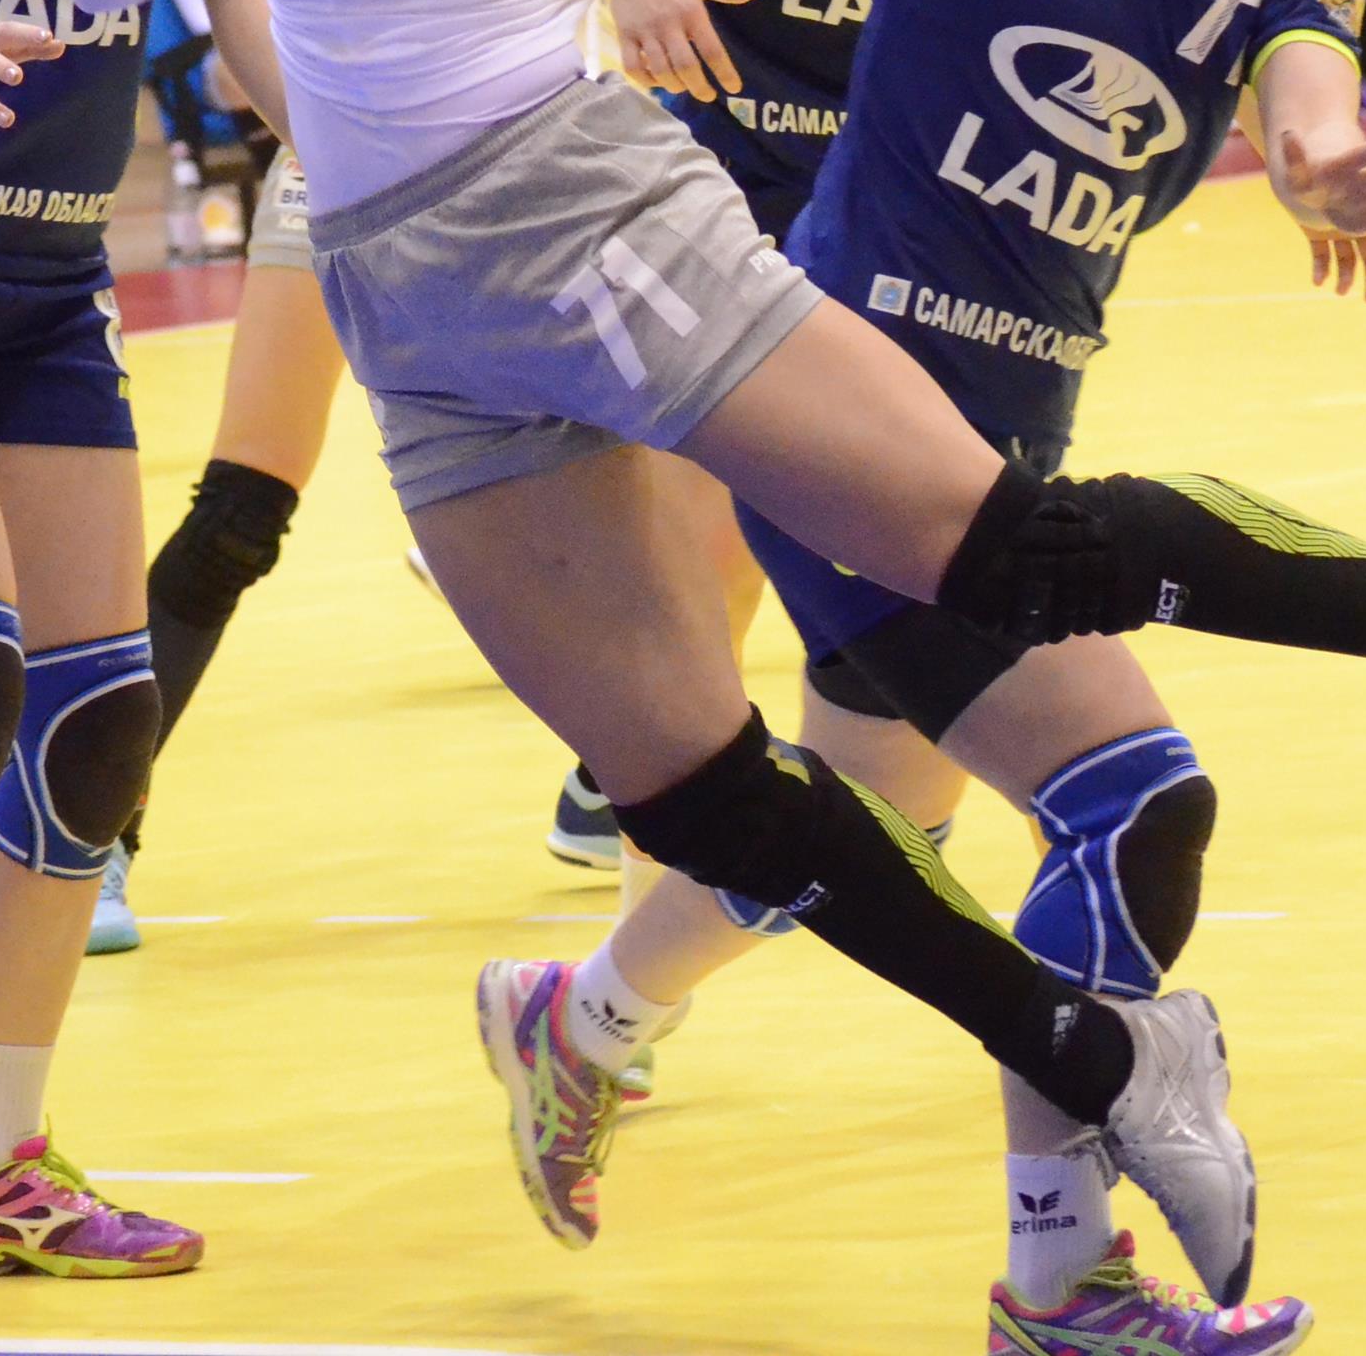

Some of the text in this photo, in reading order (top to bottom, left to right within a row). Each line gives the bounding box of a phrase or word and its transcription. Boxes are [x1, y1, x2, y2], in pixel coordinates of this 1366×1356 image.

[937, 111, 1146, 257] LADA
[549, 236, 702, 391] 71
[914, 286, 1067, 365] САМАРСКА
[1012, 1215, 1077, 1235] erima
